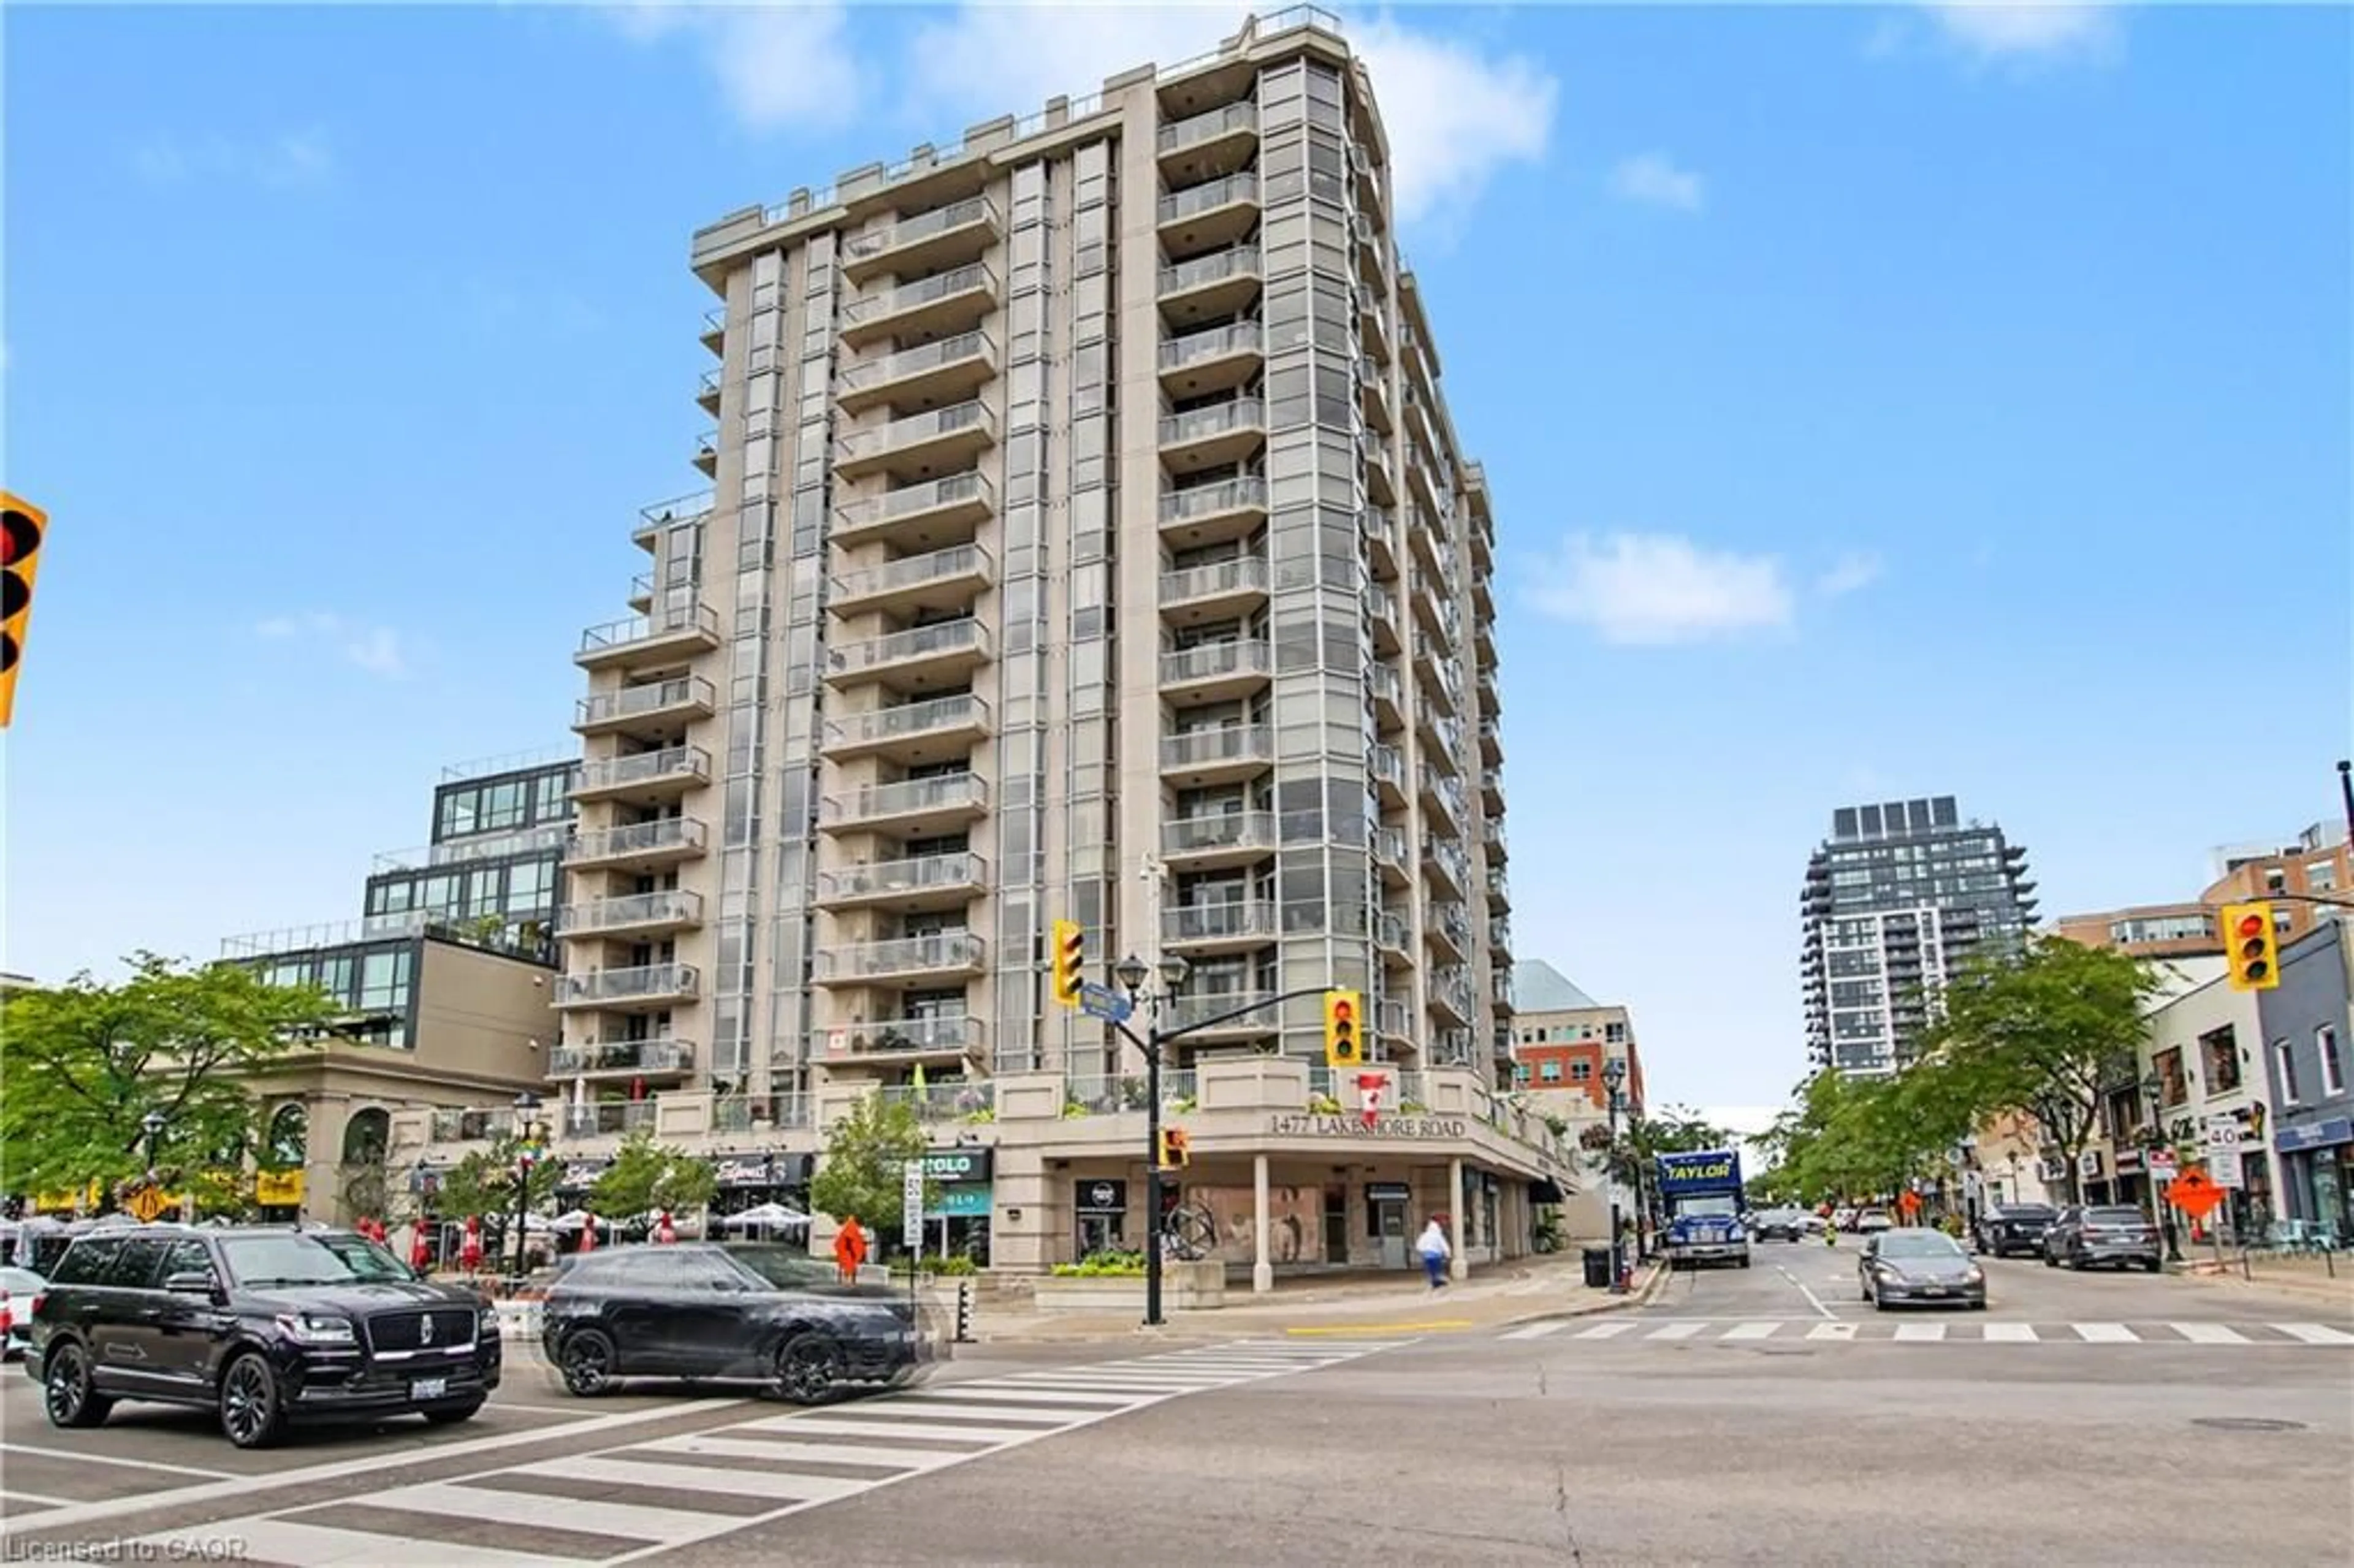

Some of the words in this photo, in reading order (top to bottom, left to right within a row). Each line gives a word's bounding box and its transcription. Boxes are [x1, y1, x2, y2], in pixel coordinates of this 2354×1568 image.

[1271, 1114, 1311, 1133] 1477
[1420, 1119, 1466, 1138] ROAD
[2211, 1128, 2236, 1144] 40
[1669, 1165, 1729, 1180] TAYLOR
